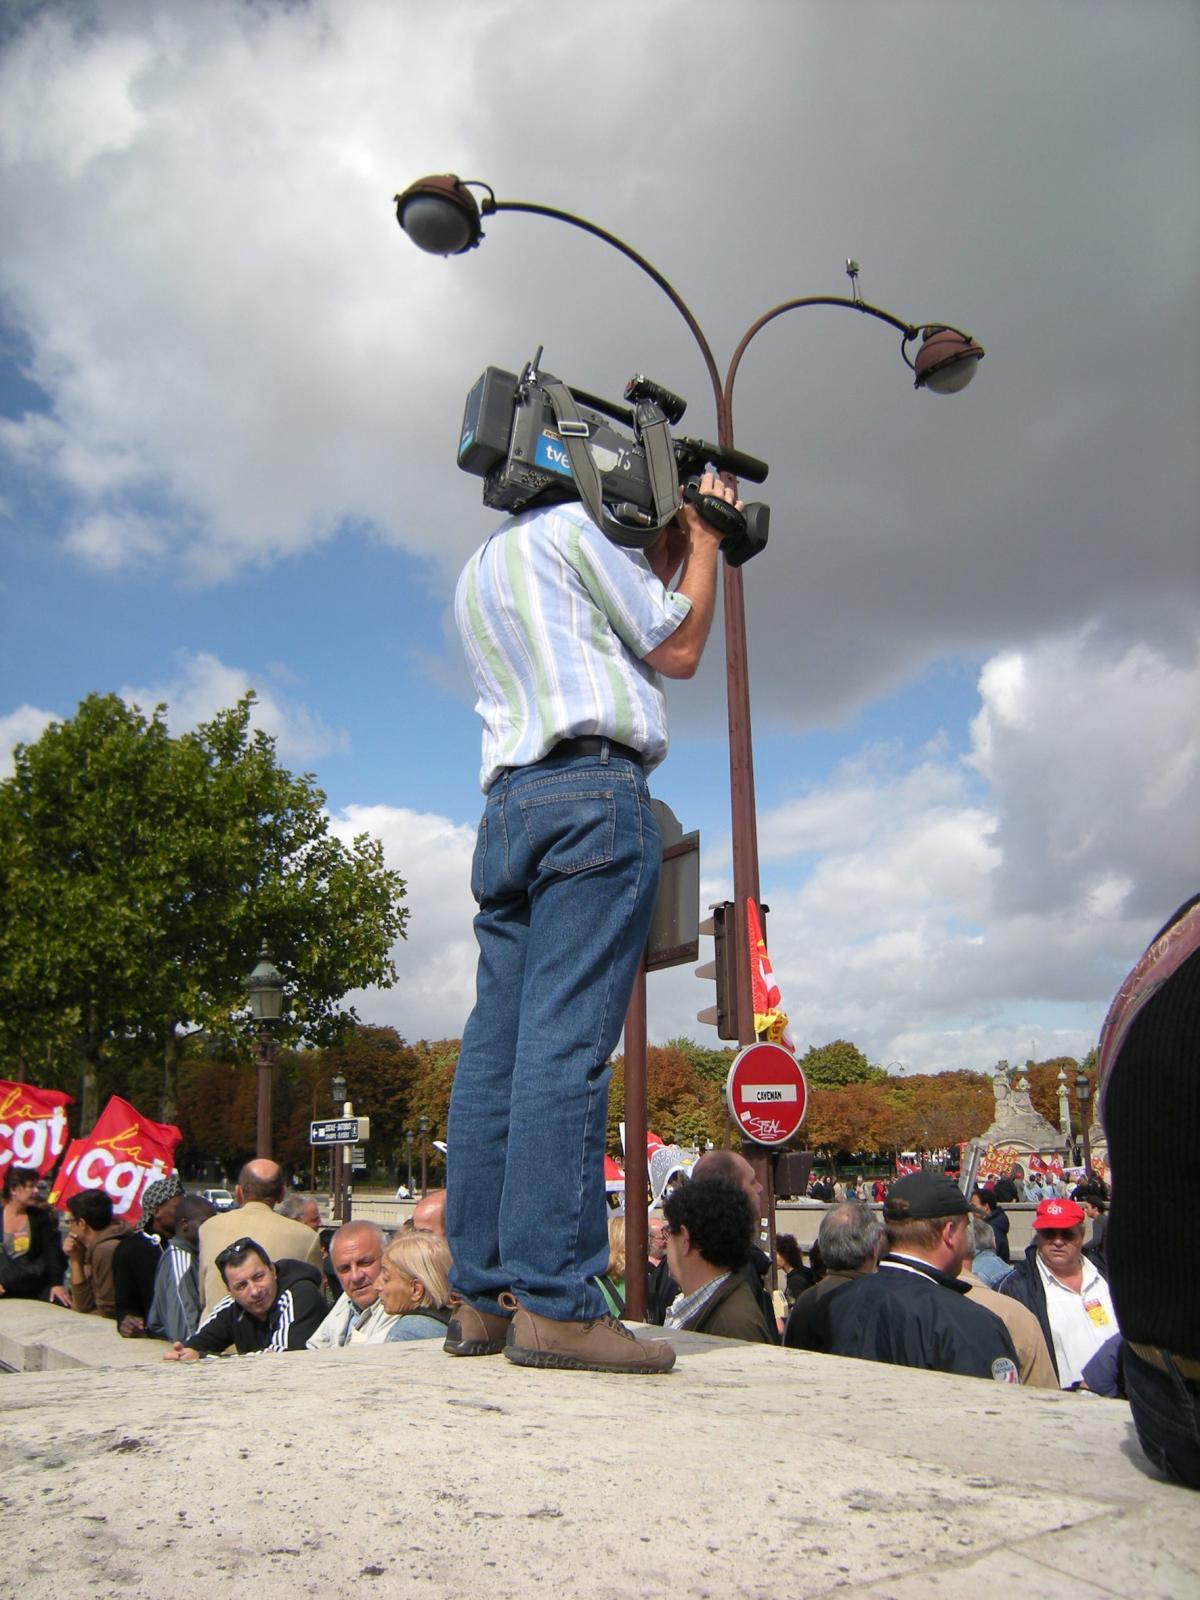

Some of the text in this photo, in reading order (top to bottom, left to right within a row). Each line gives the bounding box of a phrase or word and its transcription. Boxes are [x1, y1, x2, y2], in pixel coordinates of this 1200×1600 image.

[546, 445, 571, 469] tve
[757, 1090, 783, 1101] CAVEMAN
[76, 1148, 166, 1214] cgt
[1046, 1204, 1063, 1215] cgt
